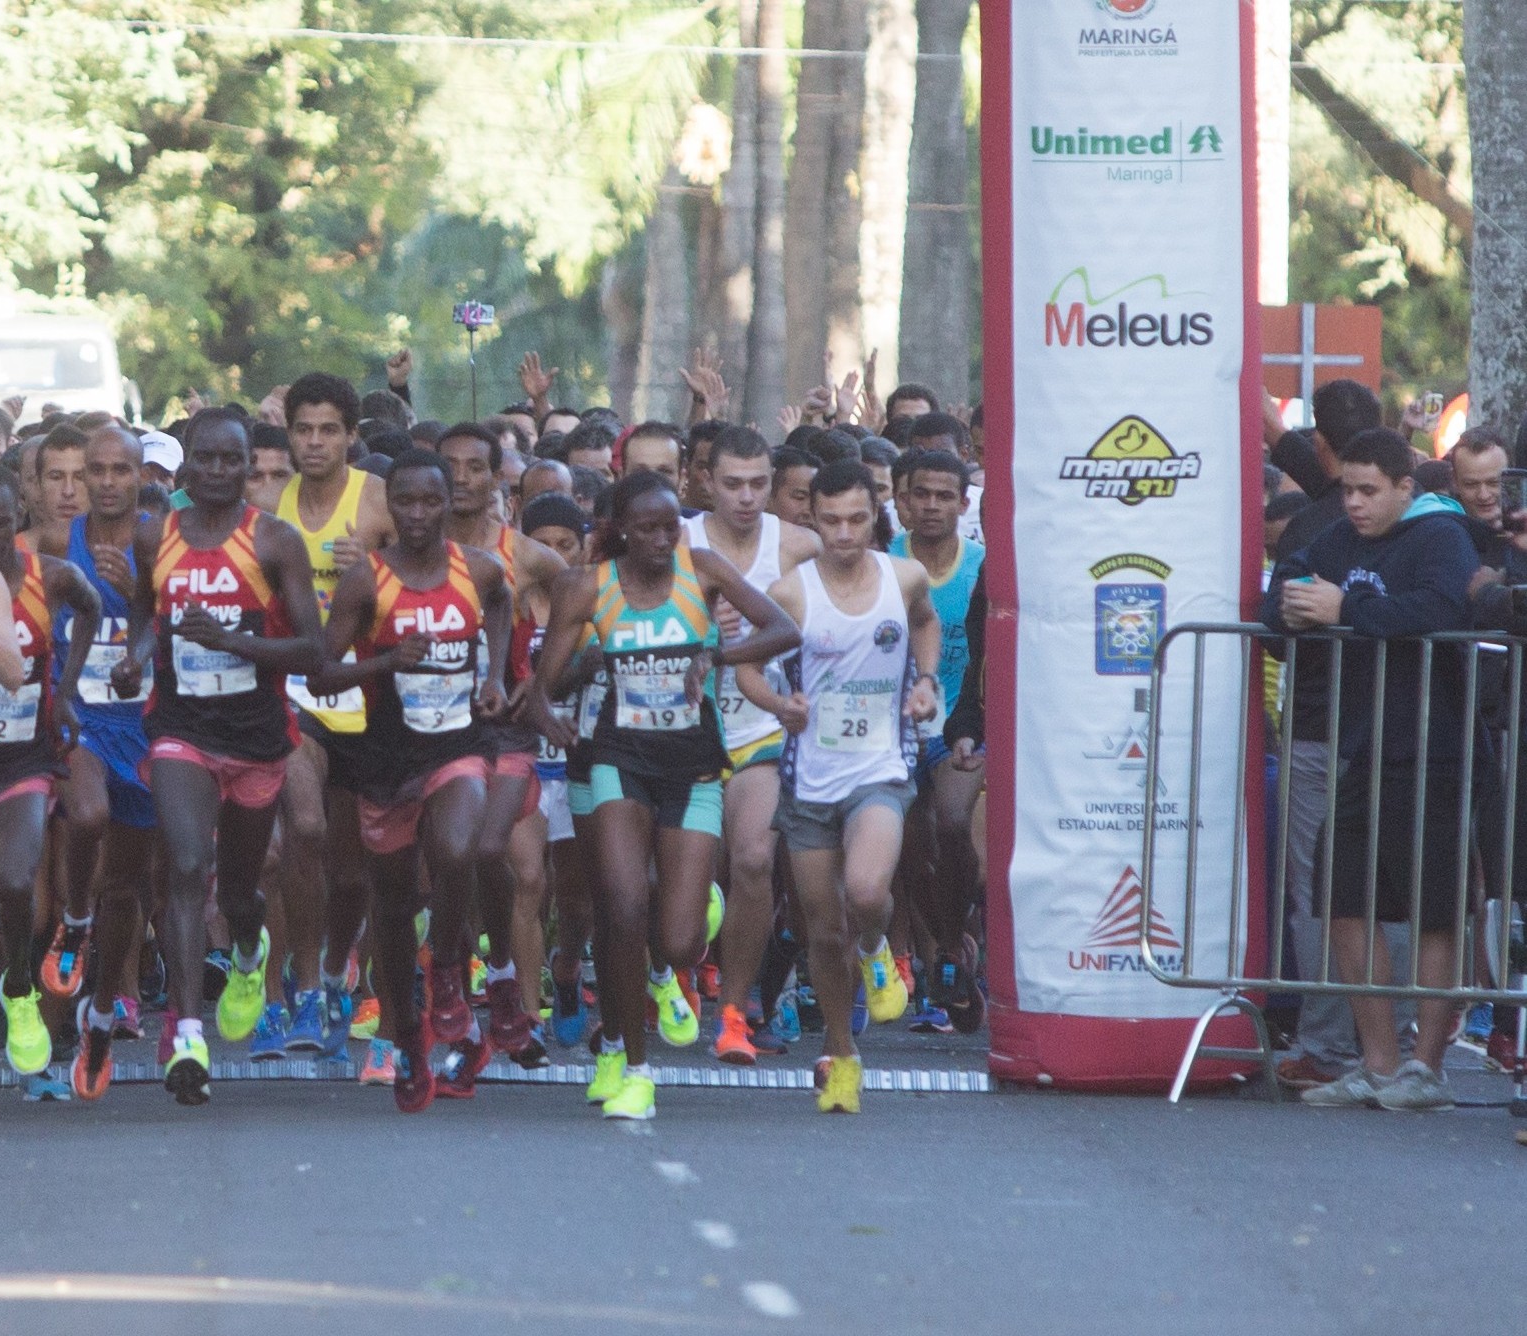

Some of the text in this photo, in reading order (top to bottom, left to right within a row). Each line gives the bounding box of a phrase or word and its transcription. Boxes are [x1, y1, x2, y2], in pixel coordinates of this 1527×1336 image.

[1079, 22, 1177, 44] MARINGÁ
[1078, 48, 1179, 57] PREFEITURA DA CIDADE
[1031, 126, 1172, 155] Unimed
[1107, 165, 1173, 183] Maringá
[1045, 302, 1213, 347] Meleus
[1061, 451, 1200, 478] MARINGÁ
[1087, 479, 1176, 497] FM 97.1
[169, 566, 240, 595] FILA
[394, 603, 466, 635] FILA
[613, 617, 688, 648] FILA
[214, 674, 222, 691] 1
[718, 698, 745, 714] 27
[649, 710, 675, 727] 19
[841, 718, 869, 737] 28
[1085, 803, 1179, 814] UNIVERSIADE
[1058, 818, 1122, 831] ESTADUAL
[1127, 819, 1145, 831] DE
